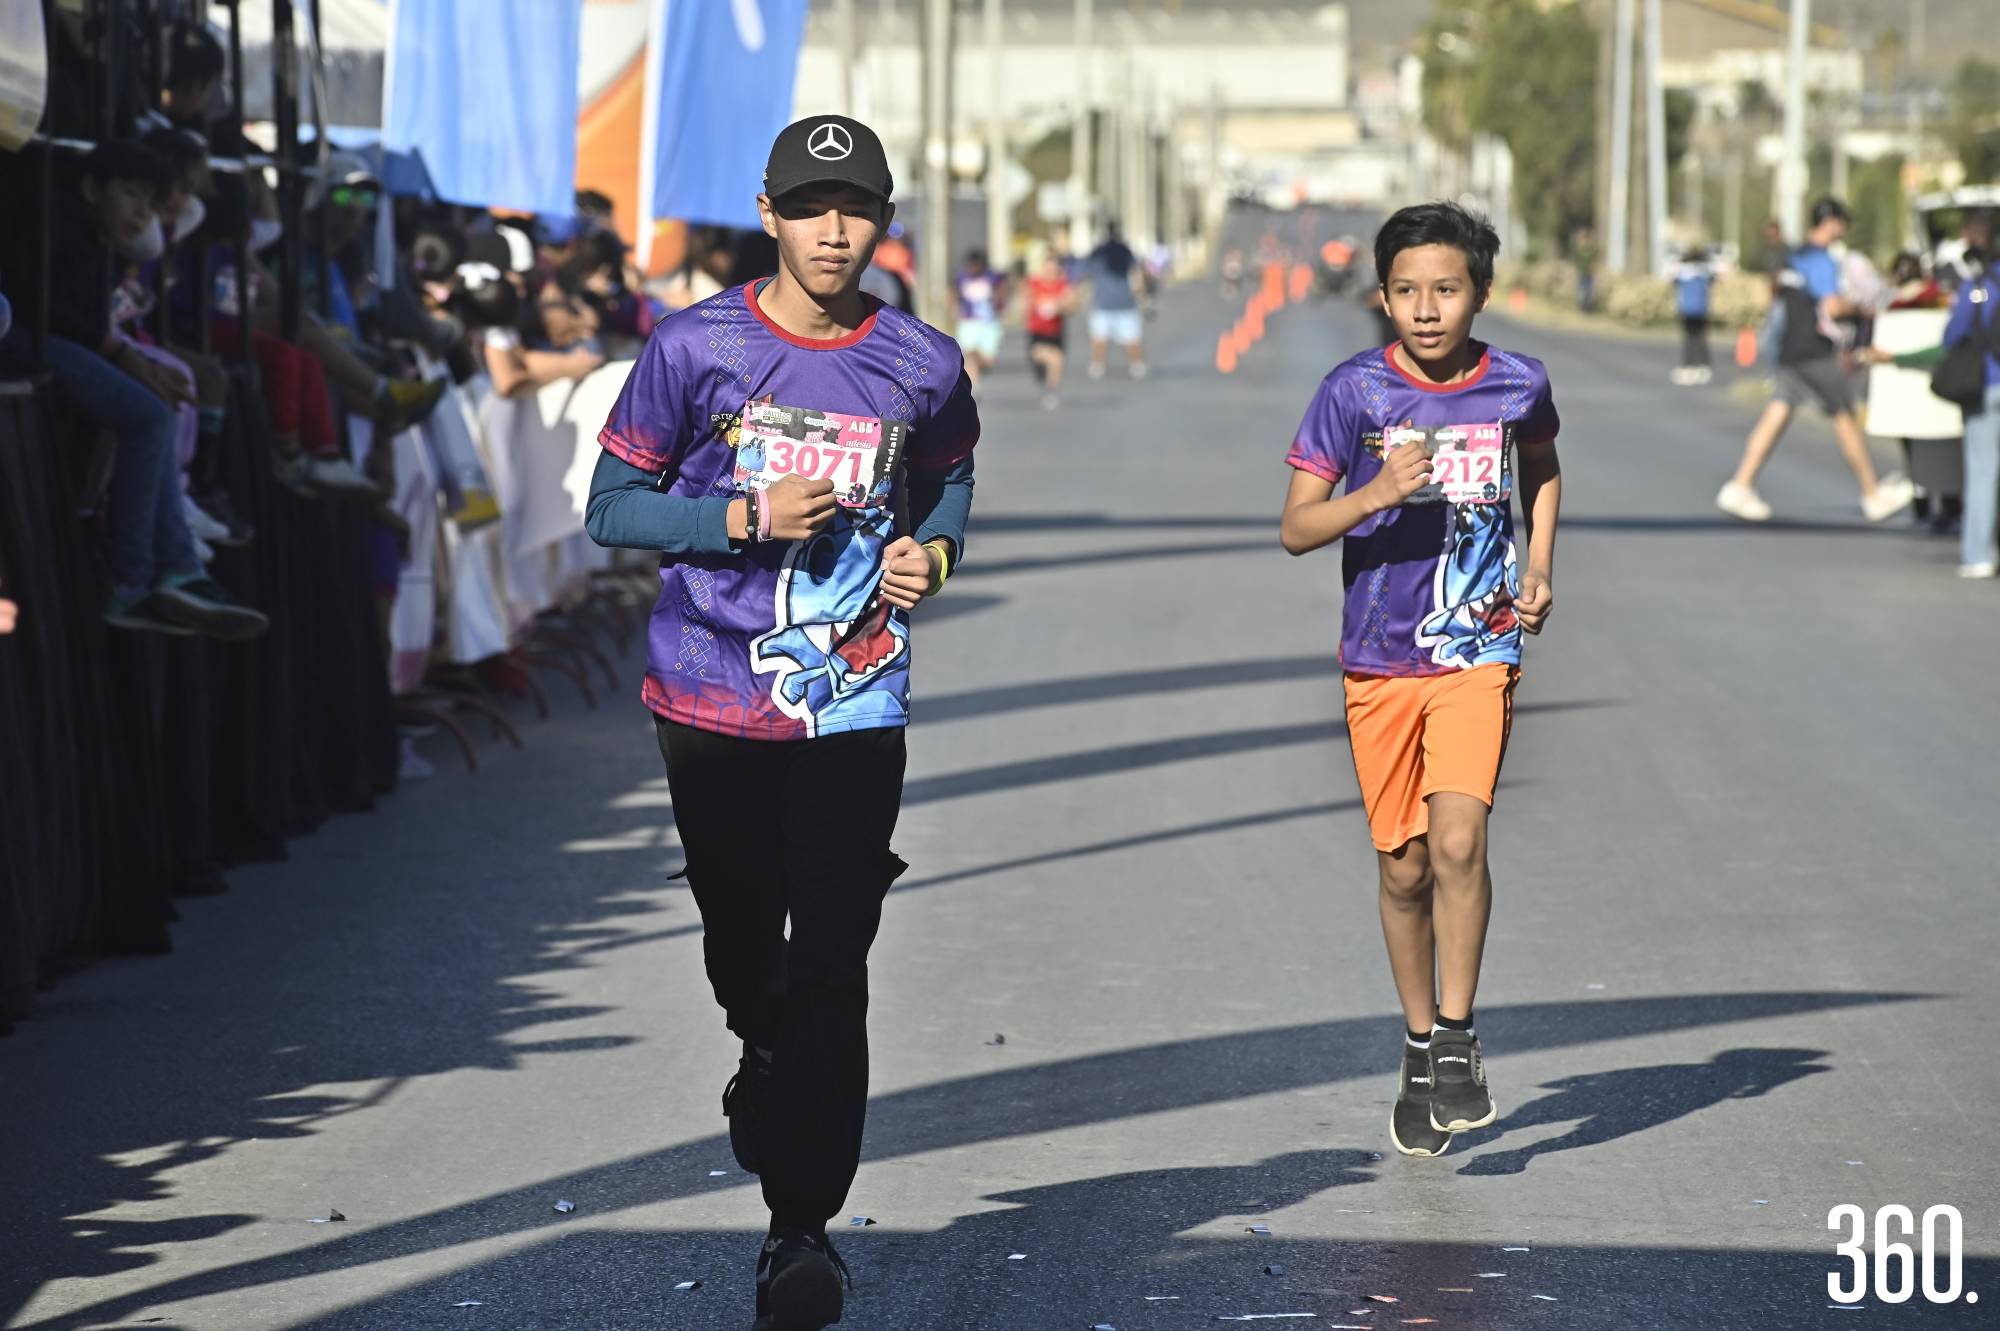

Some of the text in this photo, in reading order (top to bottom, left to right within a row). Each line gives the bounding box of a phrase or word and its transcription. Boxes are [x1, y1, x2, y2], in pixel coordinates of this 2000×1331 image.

[848, 420, 873, 434] ABB
[769, 441, 862, 482] 3071
[883, 426, 899, 472] Medalla
[1435, 455, 1494, 483] 212
